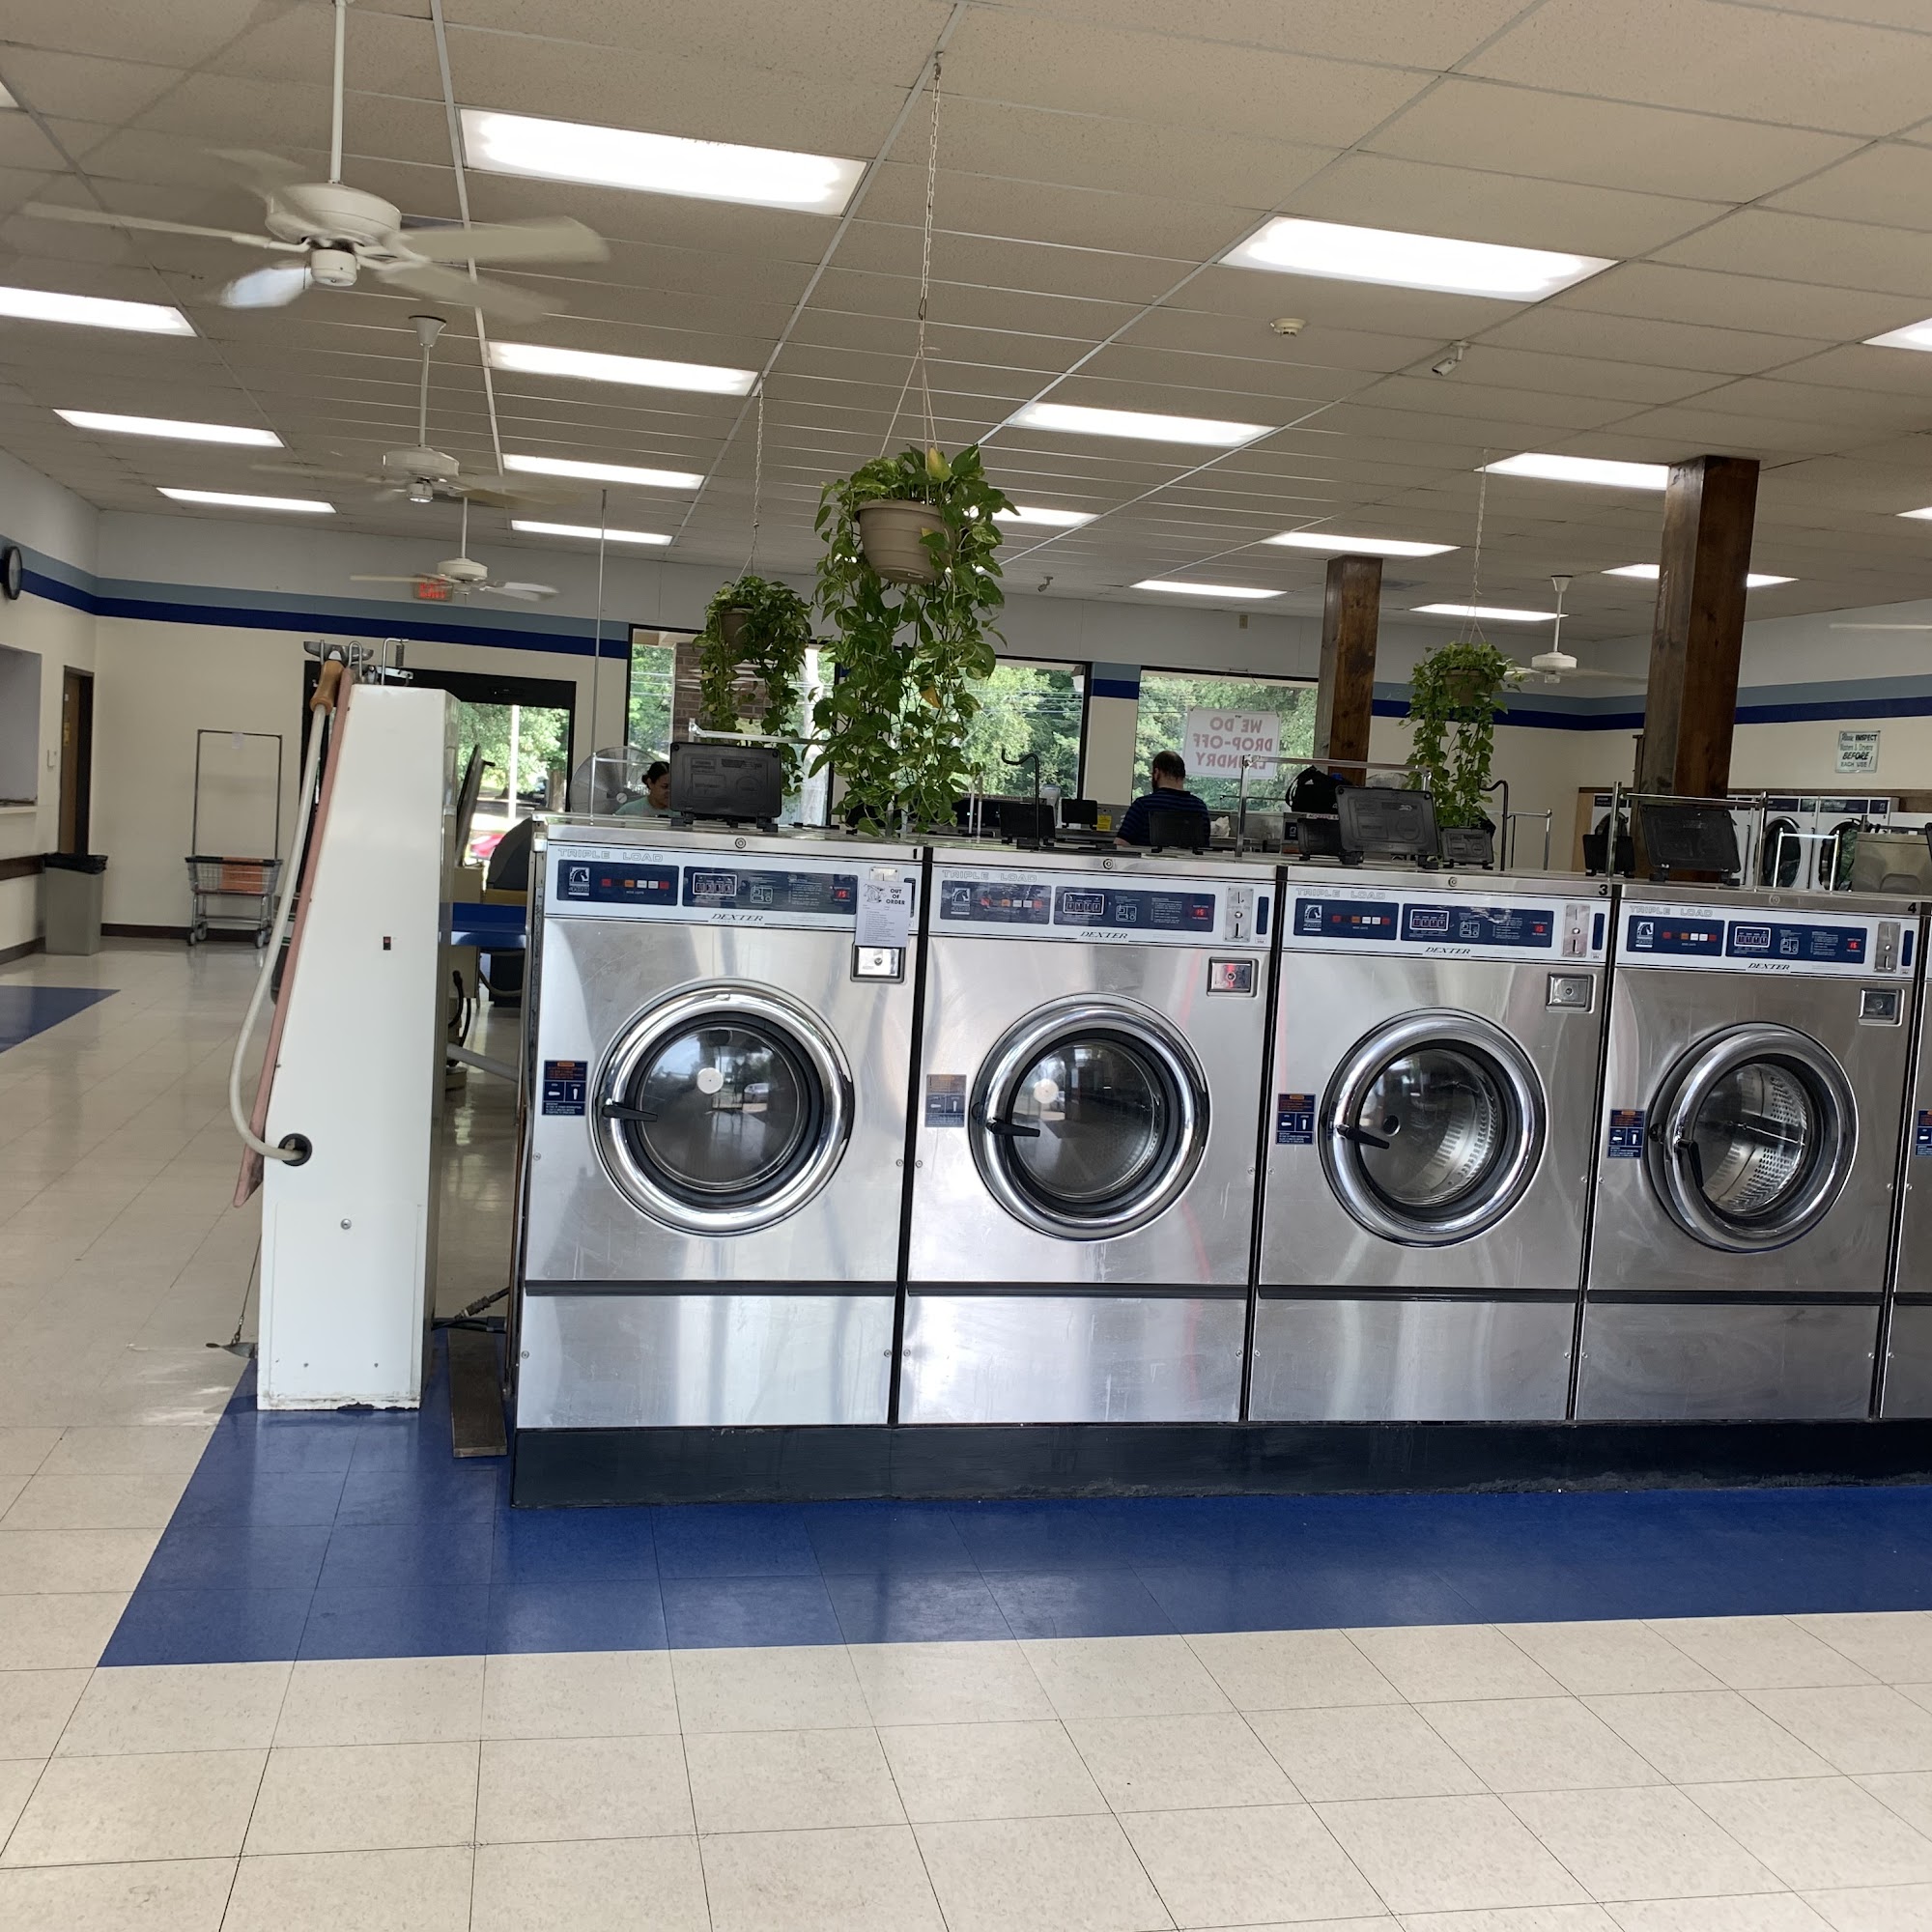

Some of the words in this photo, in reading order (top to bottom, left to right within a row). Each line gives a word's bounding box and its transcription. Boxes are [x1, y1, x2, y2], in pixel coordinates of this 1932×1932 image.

[1842, 752, 1870, 760] BEFORE
[557, 848, 611, 860] TRIPLE
[622, 851, 664, 863] LOAD
[942, 869, 989, 881] TRIPLE
[1000, 872, 1037, 883] LOAD
[1295, 887, 1341, 898] TRIPLE
[1350, 890, 1386, 900] LOAD
[1598, 883, 1608, 896] 3
[1629, 905, 1671, 916] TRIPLE
[1680, 907, 1714, 918] LOAD
[1907, 902, 1918, 914] 4
[711, 913, 764, 922] DEXTER
[1080, 930, 1128, 939] DEXTER
[1424, 946, 1471, 955] DEXTER
[1747, 961, 1791, 971] DEXTER
